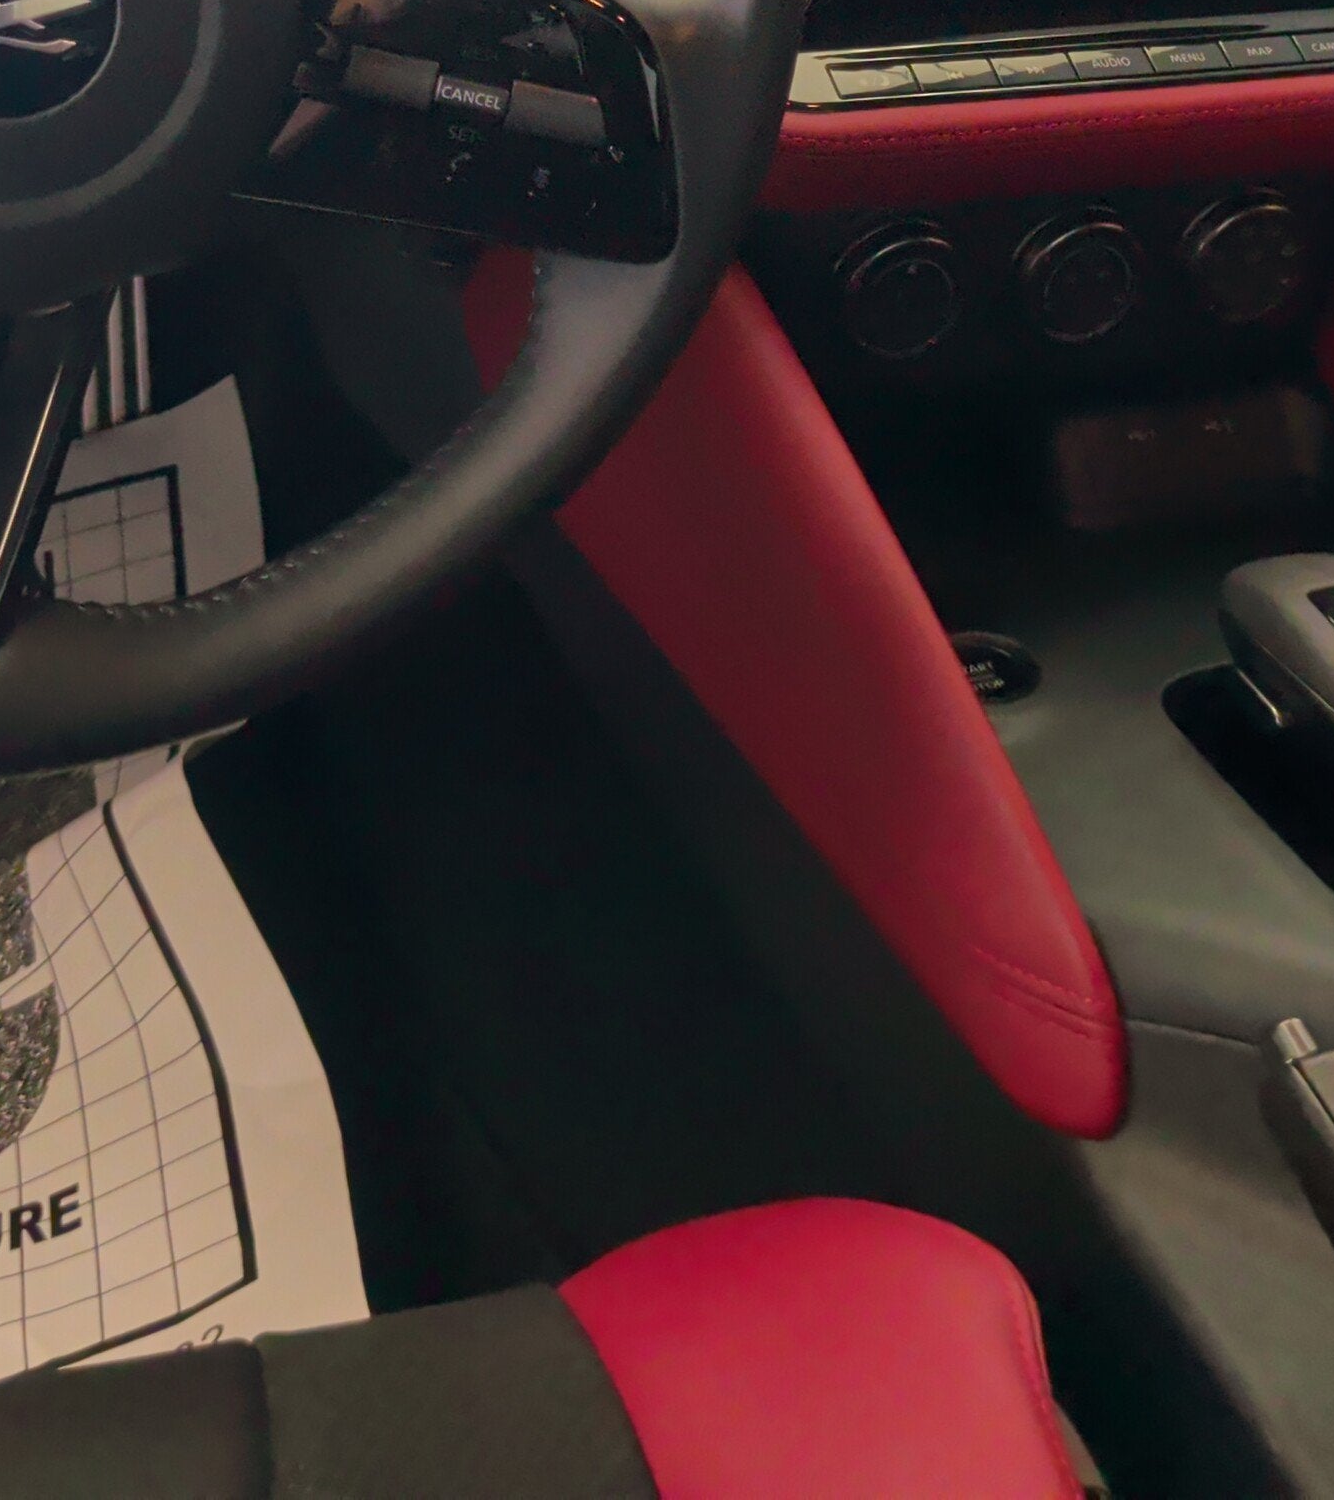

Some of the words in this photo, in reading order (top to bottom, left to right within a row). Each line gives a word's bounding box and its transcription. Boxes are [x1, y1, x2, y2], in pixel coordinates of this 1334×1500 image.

[1247, 46, 1273, 57] MAP
[1092, 56, 1131, 68] AUDIO
[1169, 52, 1206, 64] MENU
[441, 85, 501, 110] CANCEL
